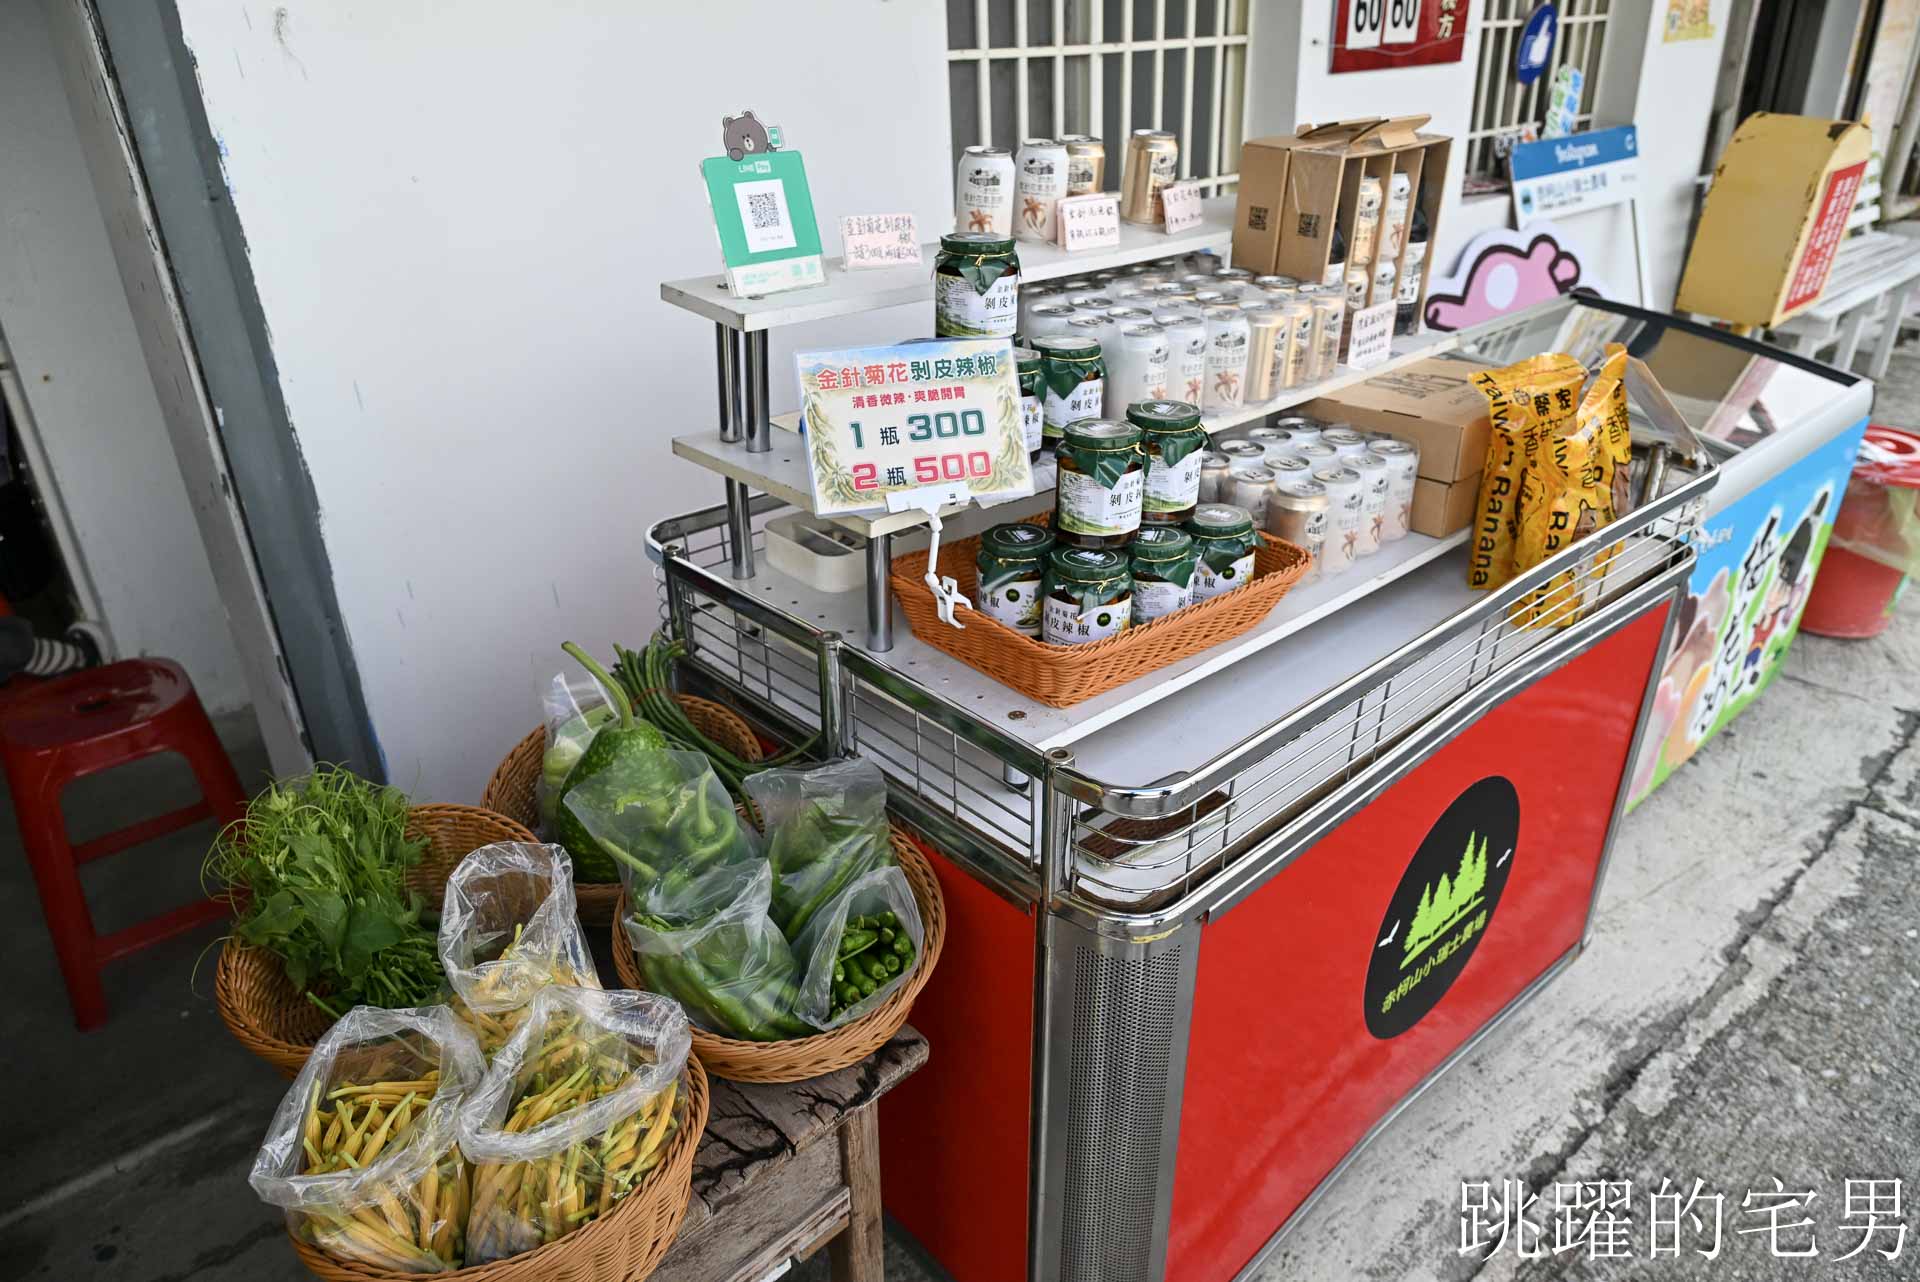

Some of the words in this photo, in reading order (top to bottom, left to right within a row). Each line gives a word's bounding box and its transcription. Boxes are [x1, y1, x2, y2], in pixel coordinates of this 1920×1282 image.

[849, 422, 864, 448] 1
[879, 426, 900, 446] 瓶
[907, 409, 985, 441] 300
[852, 462, 879, 490] 2
[887, 466, 907, 486] 瓶
[914, 451, 991, 483] 500
